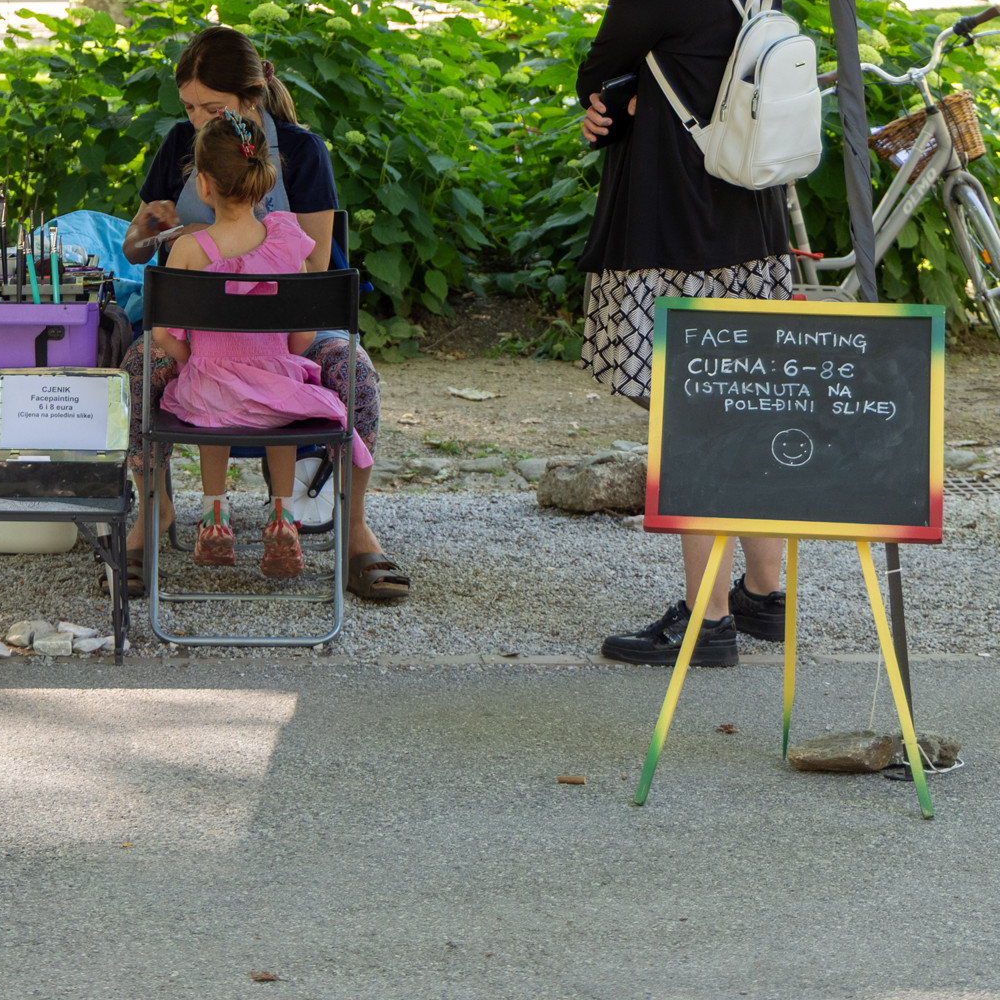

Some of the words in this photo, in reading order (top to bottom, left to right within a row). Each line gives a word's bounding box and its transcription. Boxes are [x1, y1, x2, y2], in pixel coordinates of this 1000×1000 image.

[901, 166, 937, 215] OLMO
[684, 328, 748, 347] FACE
[776, 329, 867, 353] PAINTING
[687, 357, 776, 375] CIJENA:
[684, 378, 810, 397] (ISTAKNUTA
[828, 382, 852, 399] NA
[30, 394, 80, 404] Facepainting
[17, 411, 40, 419] (Cijena
[76, 412, 94, 420] slike)
[831, 401, 897, 421] SLIKE)
